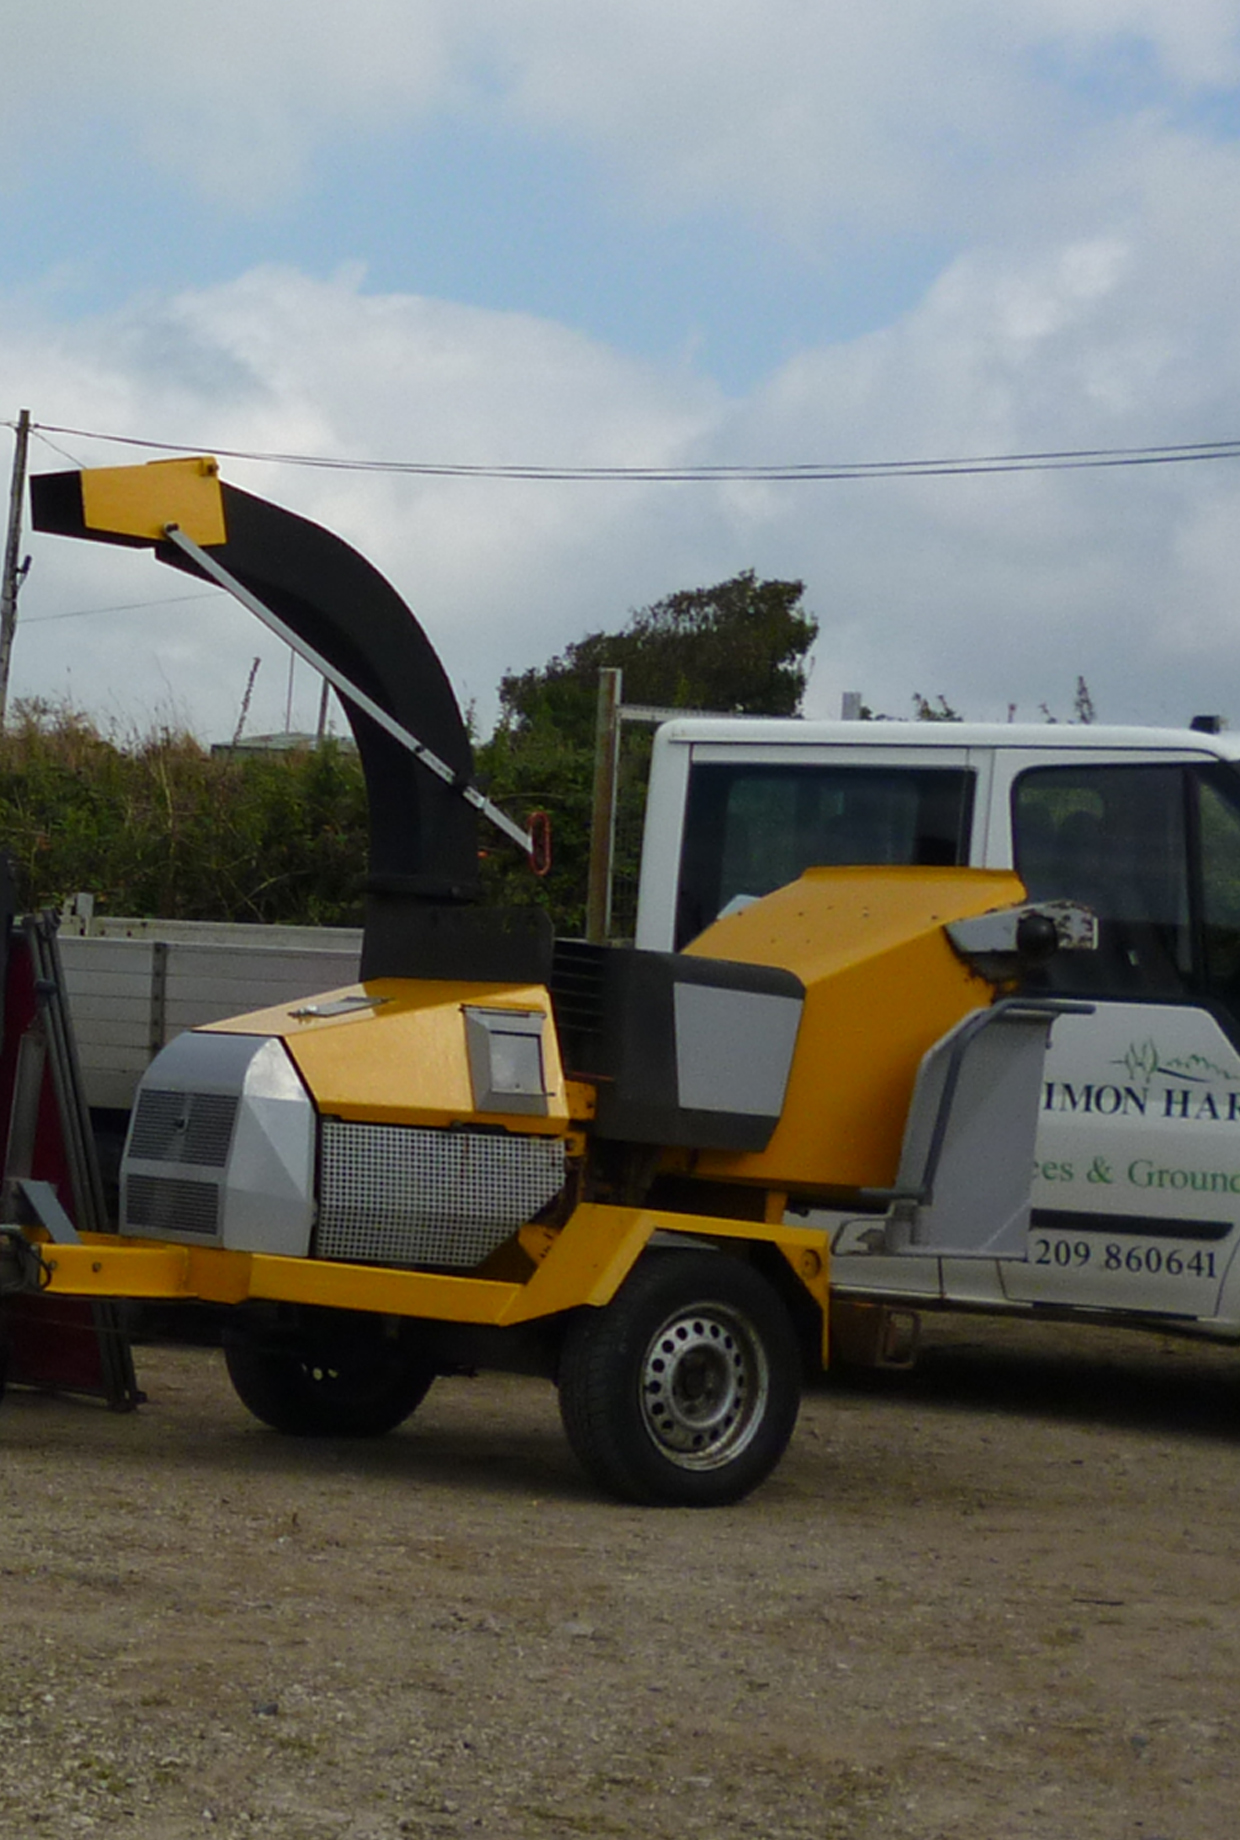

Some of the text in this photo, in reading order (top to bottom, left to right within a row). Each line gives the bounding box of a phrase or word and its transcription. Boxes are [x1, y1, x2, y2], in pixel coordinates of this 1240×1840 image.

[1085, 1155, 1114, 1185] &
[1022, 1238, 1218, 1279] 209 860641
